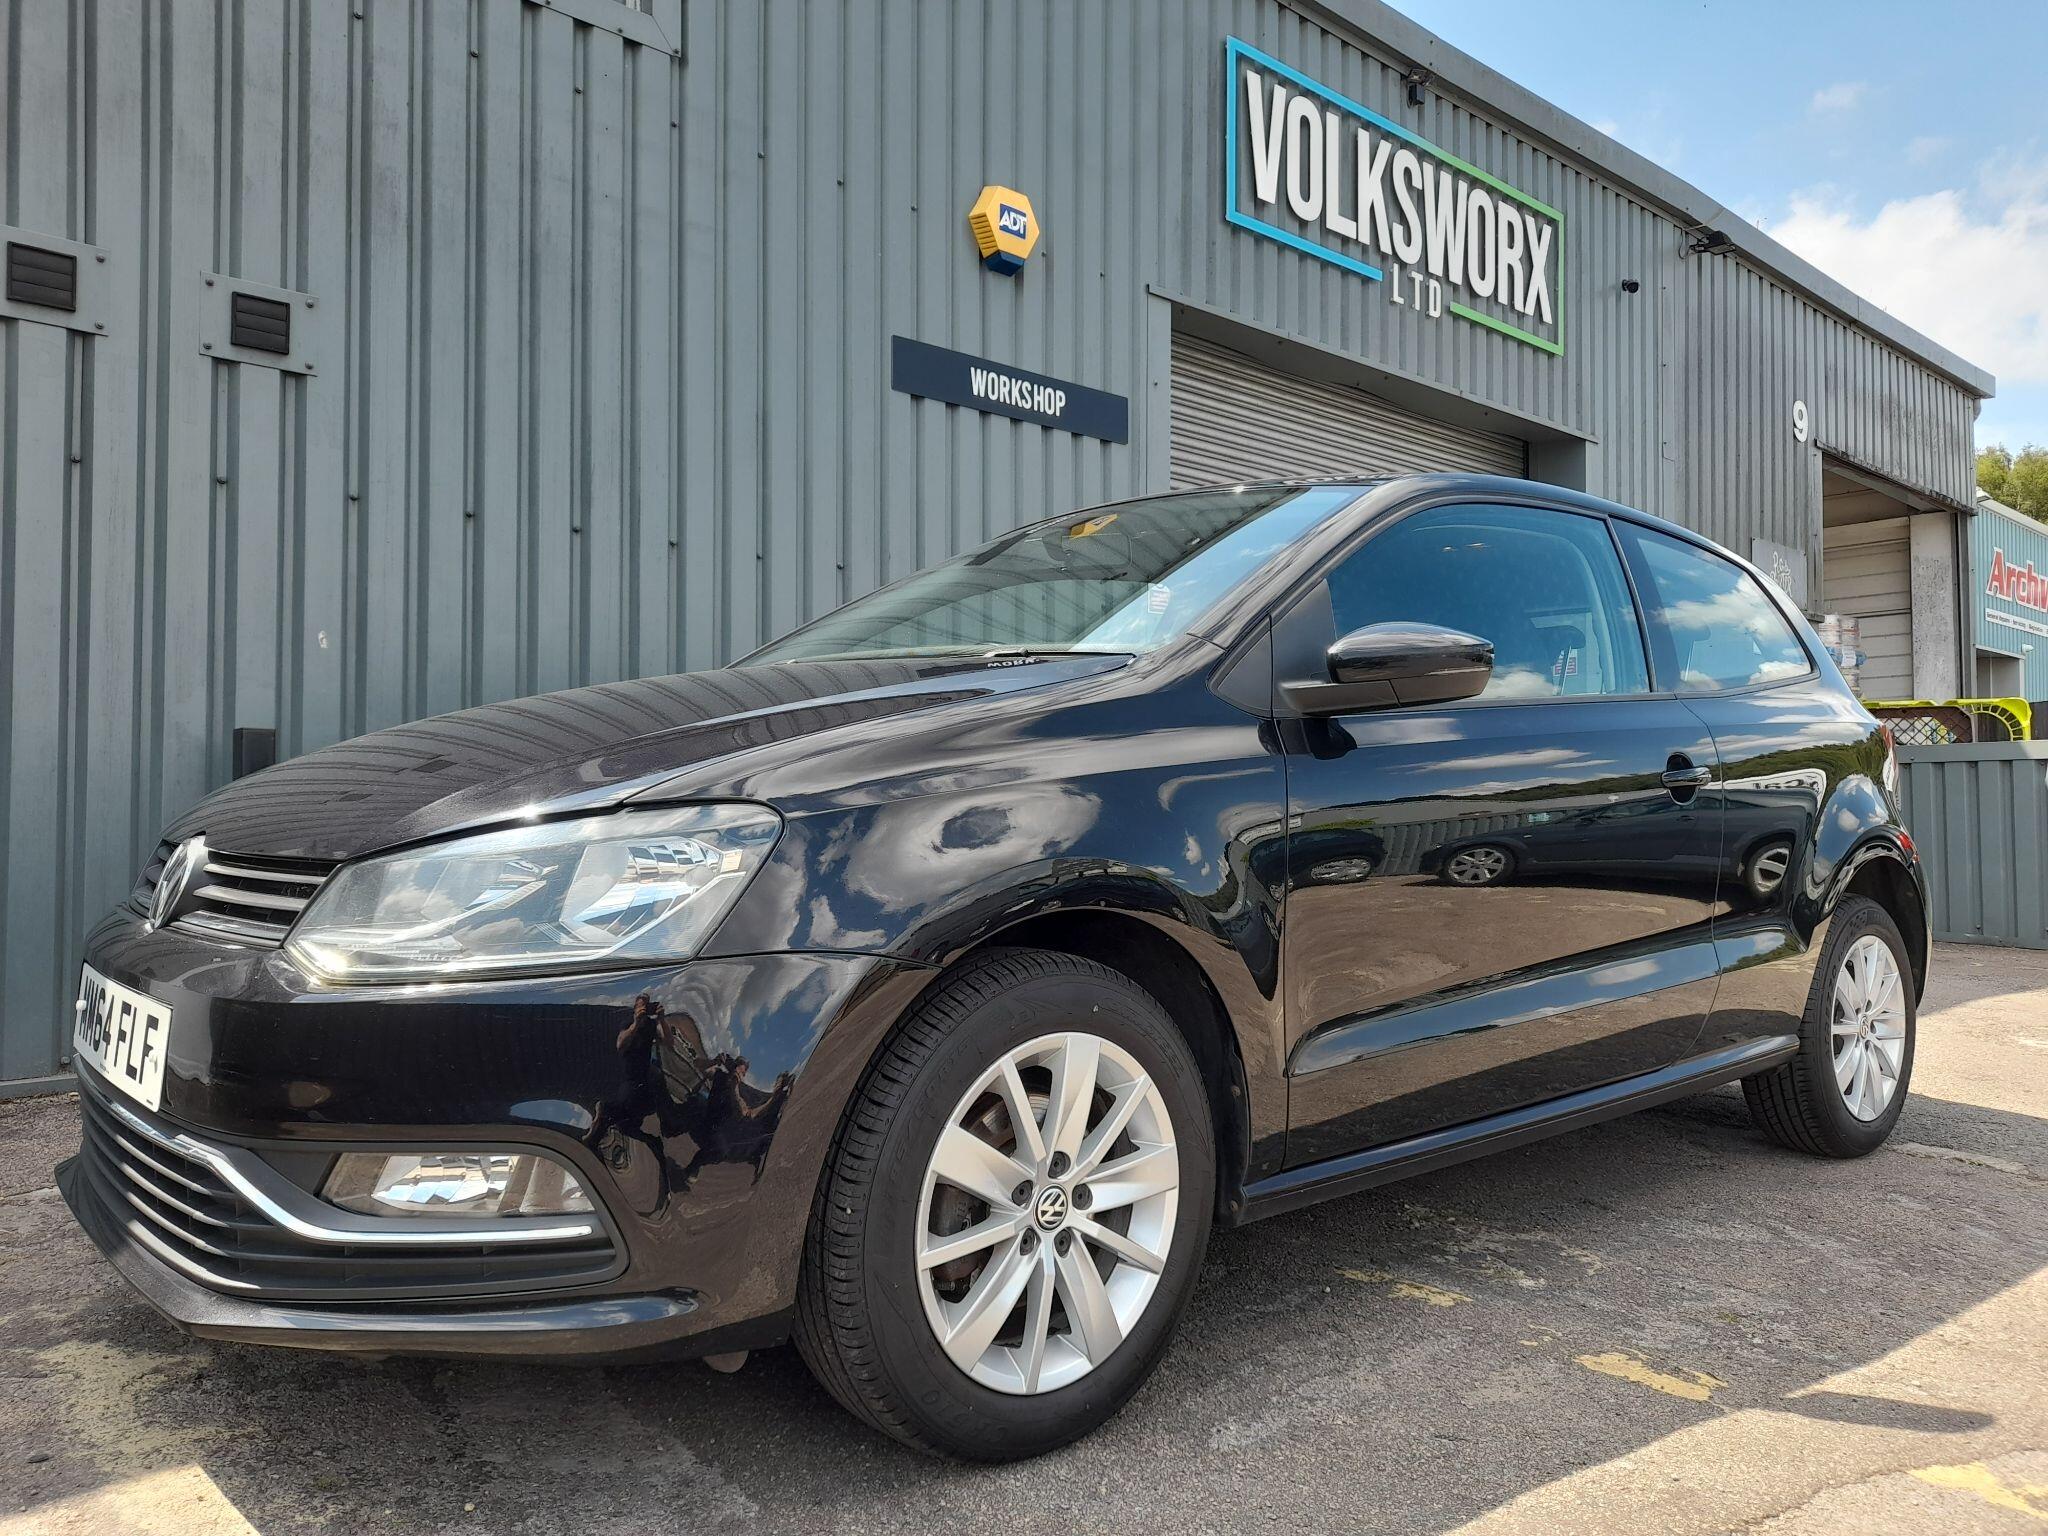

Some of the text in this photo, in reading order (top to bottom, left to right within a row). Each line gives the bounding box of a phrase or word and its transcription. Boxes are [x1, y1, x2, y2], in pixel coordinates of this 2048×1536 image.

[999, 209, 1028, 235] ADT
[1246, 70, 1553, 325] VOLKSWORX
[1391, 263, 1442, 319] LTD
[970, 366, 1066, 417] WORKSHOP
[1792, 400, 1808, 443] 9
[114, 1000, 160, 1085] FLF
